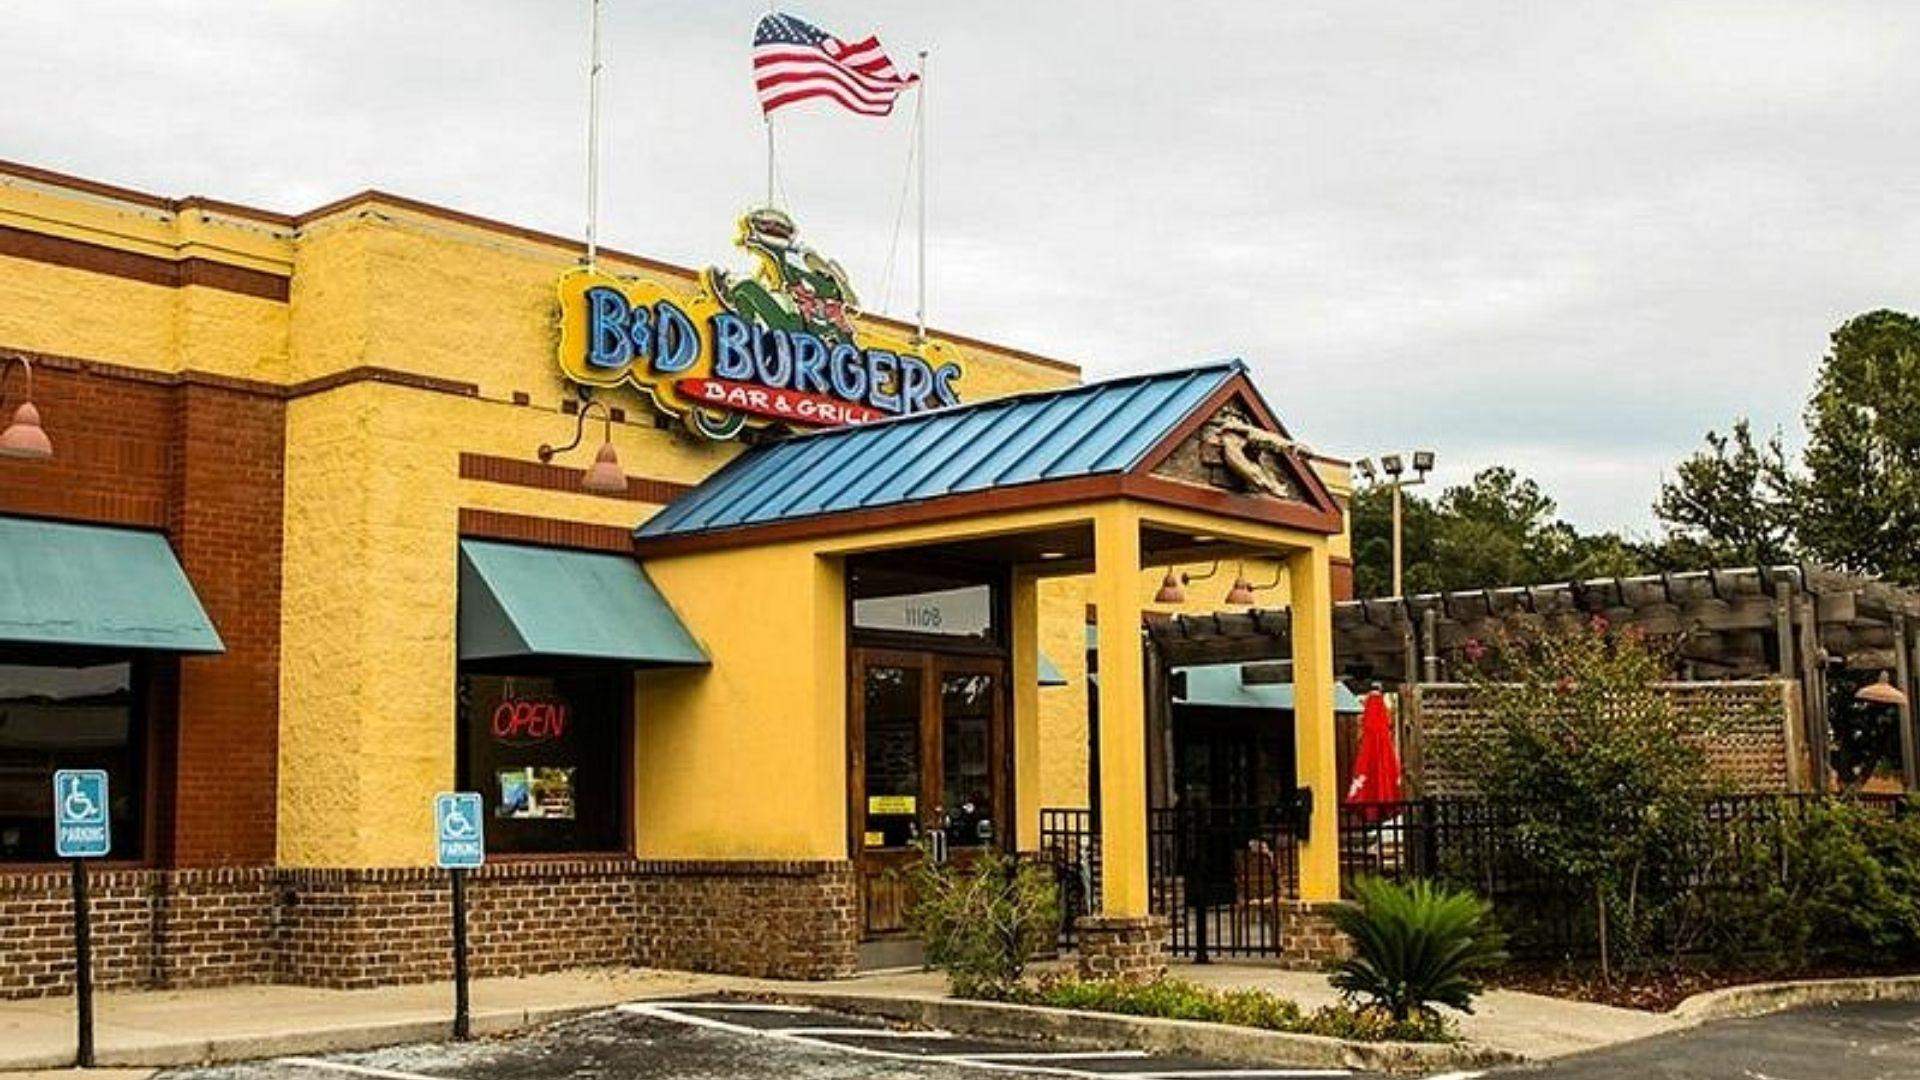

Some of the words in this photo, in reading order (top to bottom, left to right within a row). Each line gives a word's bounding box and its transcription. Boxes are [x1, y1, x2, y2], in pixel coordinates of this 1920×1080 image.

[586, 287, 700, 373] B&D
[713, 312, 961, 414] BURGERS
[702, 381, 769, 409] BAR
[774, 394, 791, 413] &
[494, 701, 566, 738] OPEN
